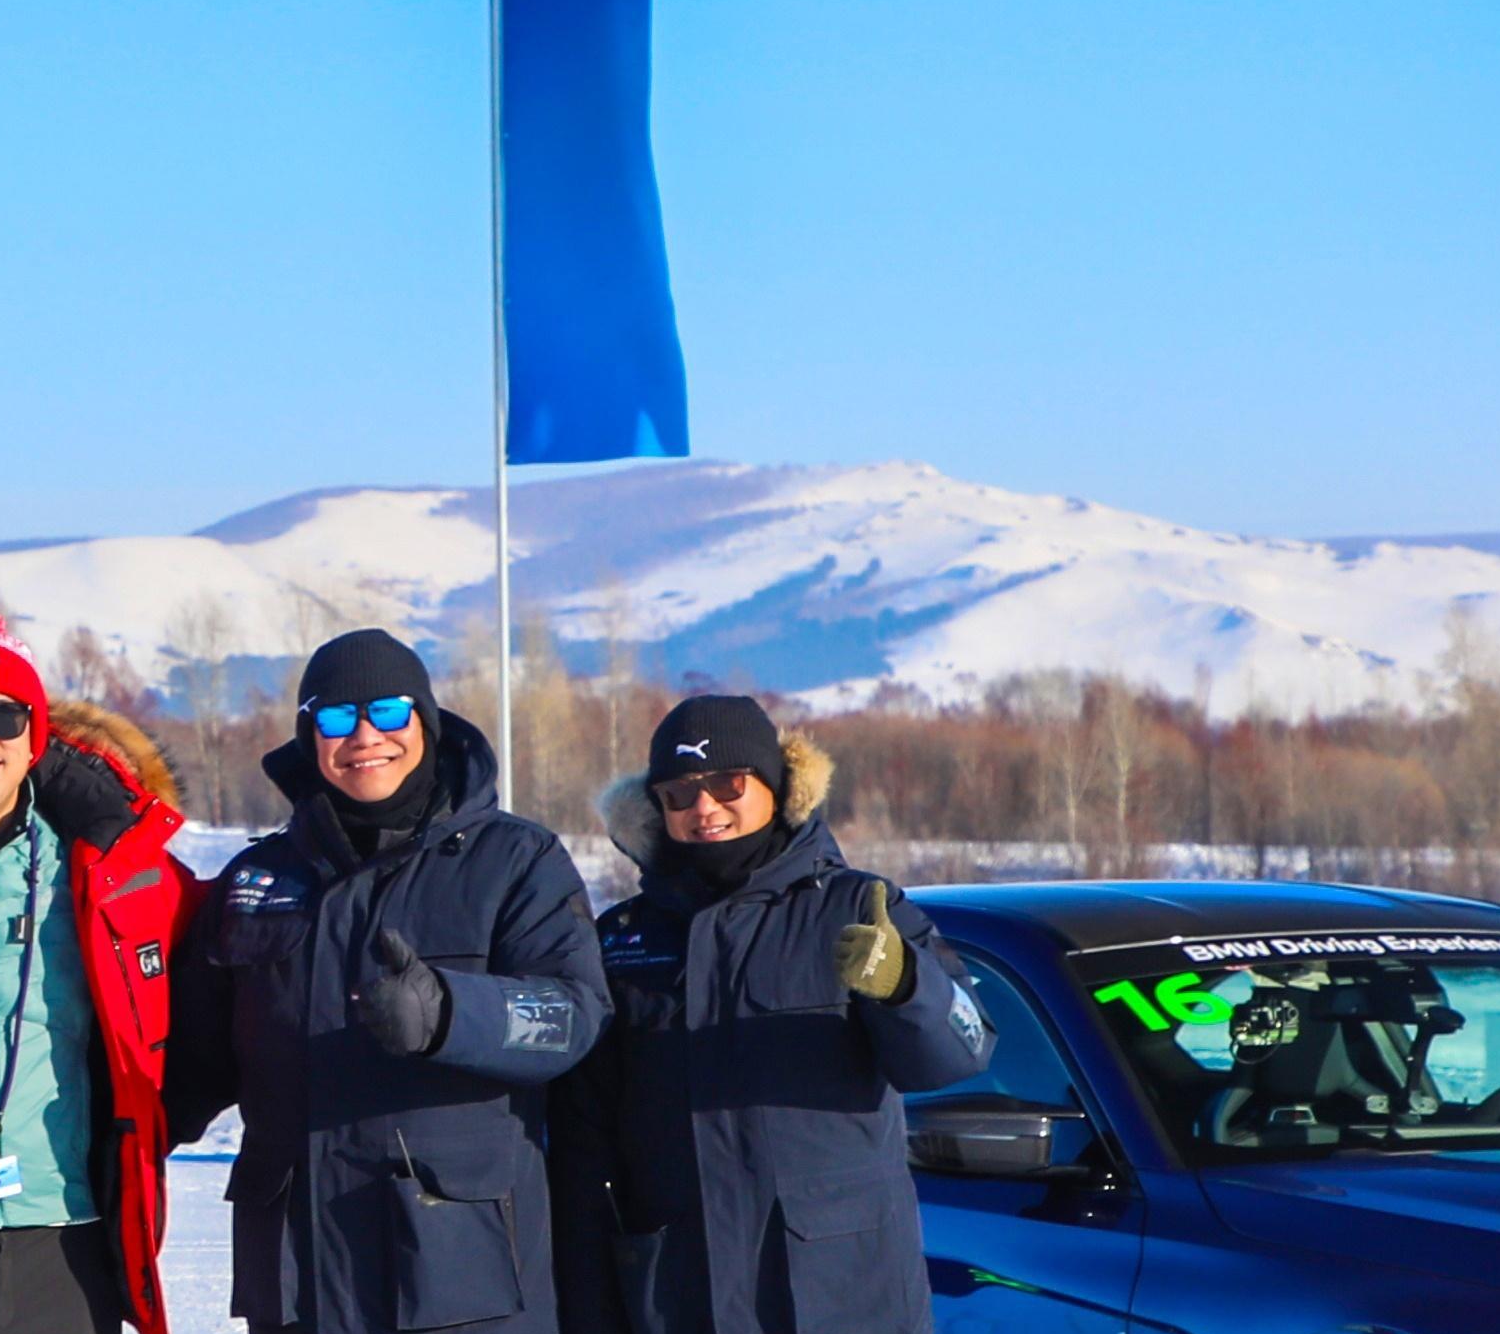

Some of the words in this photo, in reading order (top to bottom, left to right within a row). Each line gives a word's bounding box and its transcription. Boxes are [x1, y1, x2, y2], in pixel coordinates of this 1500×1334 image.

[1183, 941, 1271, 962] BMW
[1271, 937, 1385, 955] Driving
[1094, 971, 1233, 1031] 16
